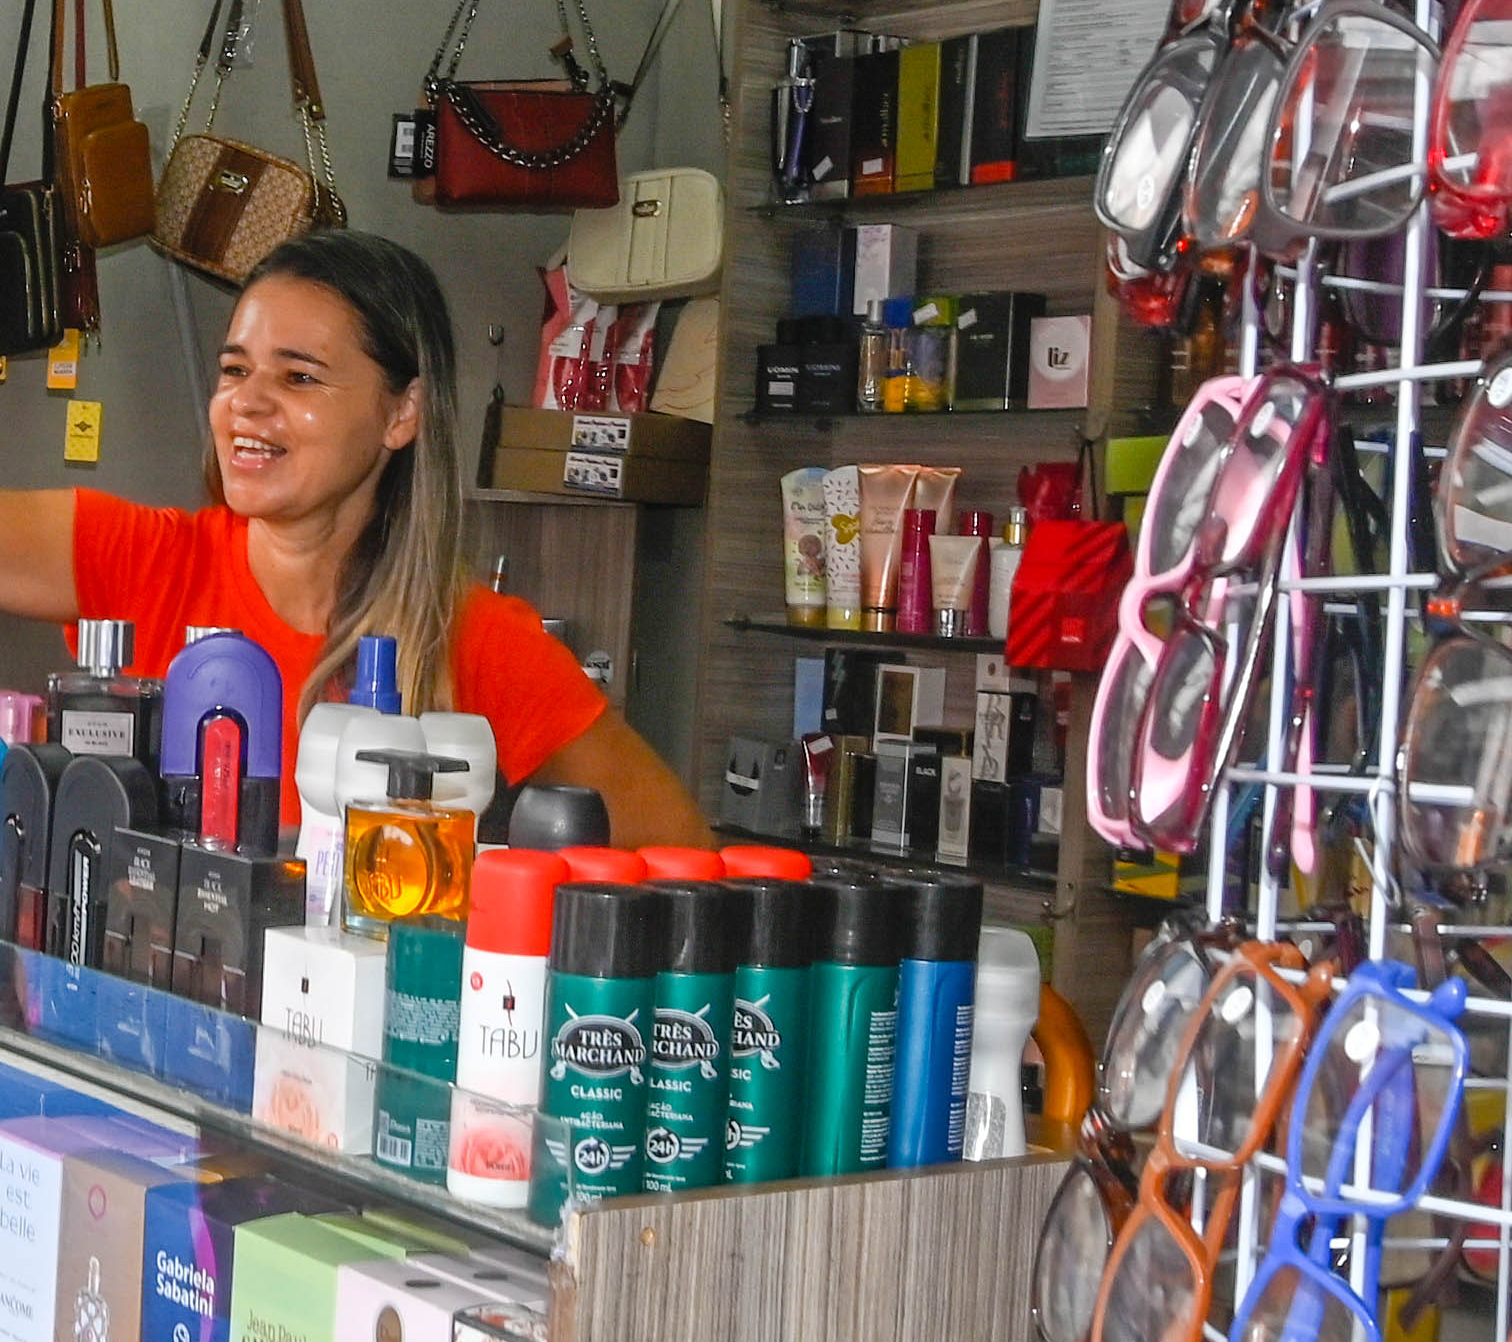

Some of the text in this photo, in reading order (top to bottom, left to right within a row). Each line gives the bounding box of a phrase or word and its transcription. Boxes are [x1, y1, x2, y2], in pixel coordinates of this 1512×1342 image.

[424, 123, 437, 169] AREZZO
[68, 727, 126, 740] EXCLUSIVE
[81, 856, 90, 915] POWER
[283, 1007, 324, 1049] TABU
[479, 1024, 539, 1060] TABU
[578, 1028, 624, 1048] TRÊS
[554, 1040, 646, 1066] MARCHAND
[570, 1084, 623, 1101] CLASSIC
[650, 1077, 692, 1093] LASSIC
[578, 1147, 608, 1164] 24h
[649, 1138, 677, 1156] 24h
[0, 1149, 41, 1186] La vie
[6, 1185, 29, 1208] est
[0, 1209, 36, 1243] belle
[156, 1250, 215, 1295] Gabriela
[156, 1273, 213, 1319] Sabatini
[246, 1310, 275, 1341] Jean
